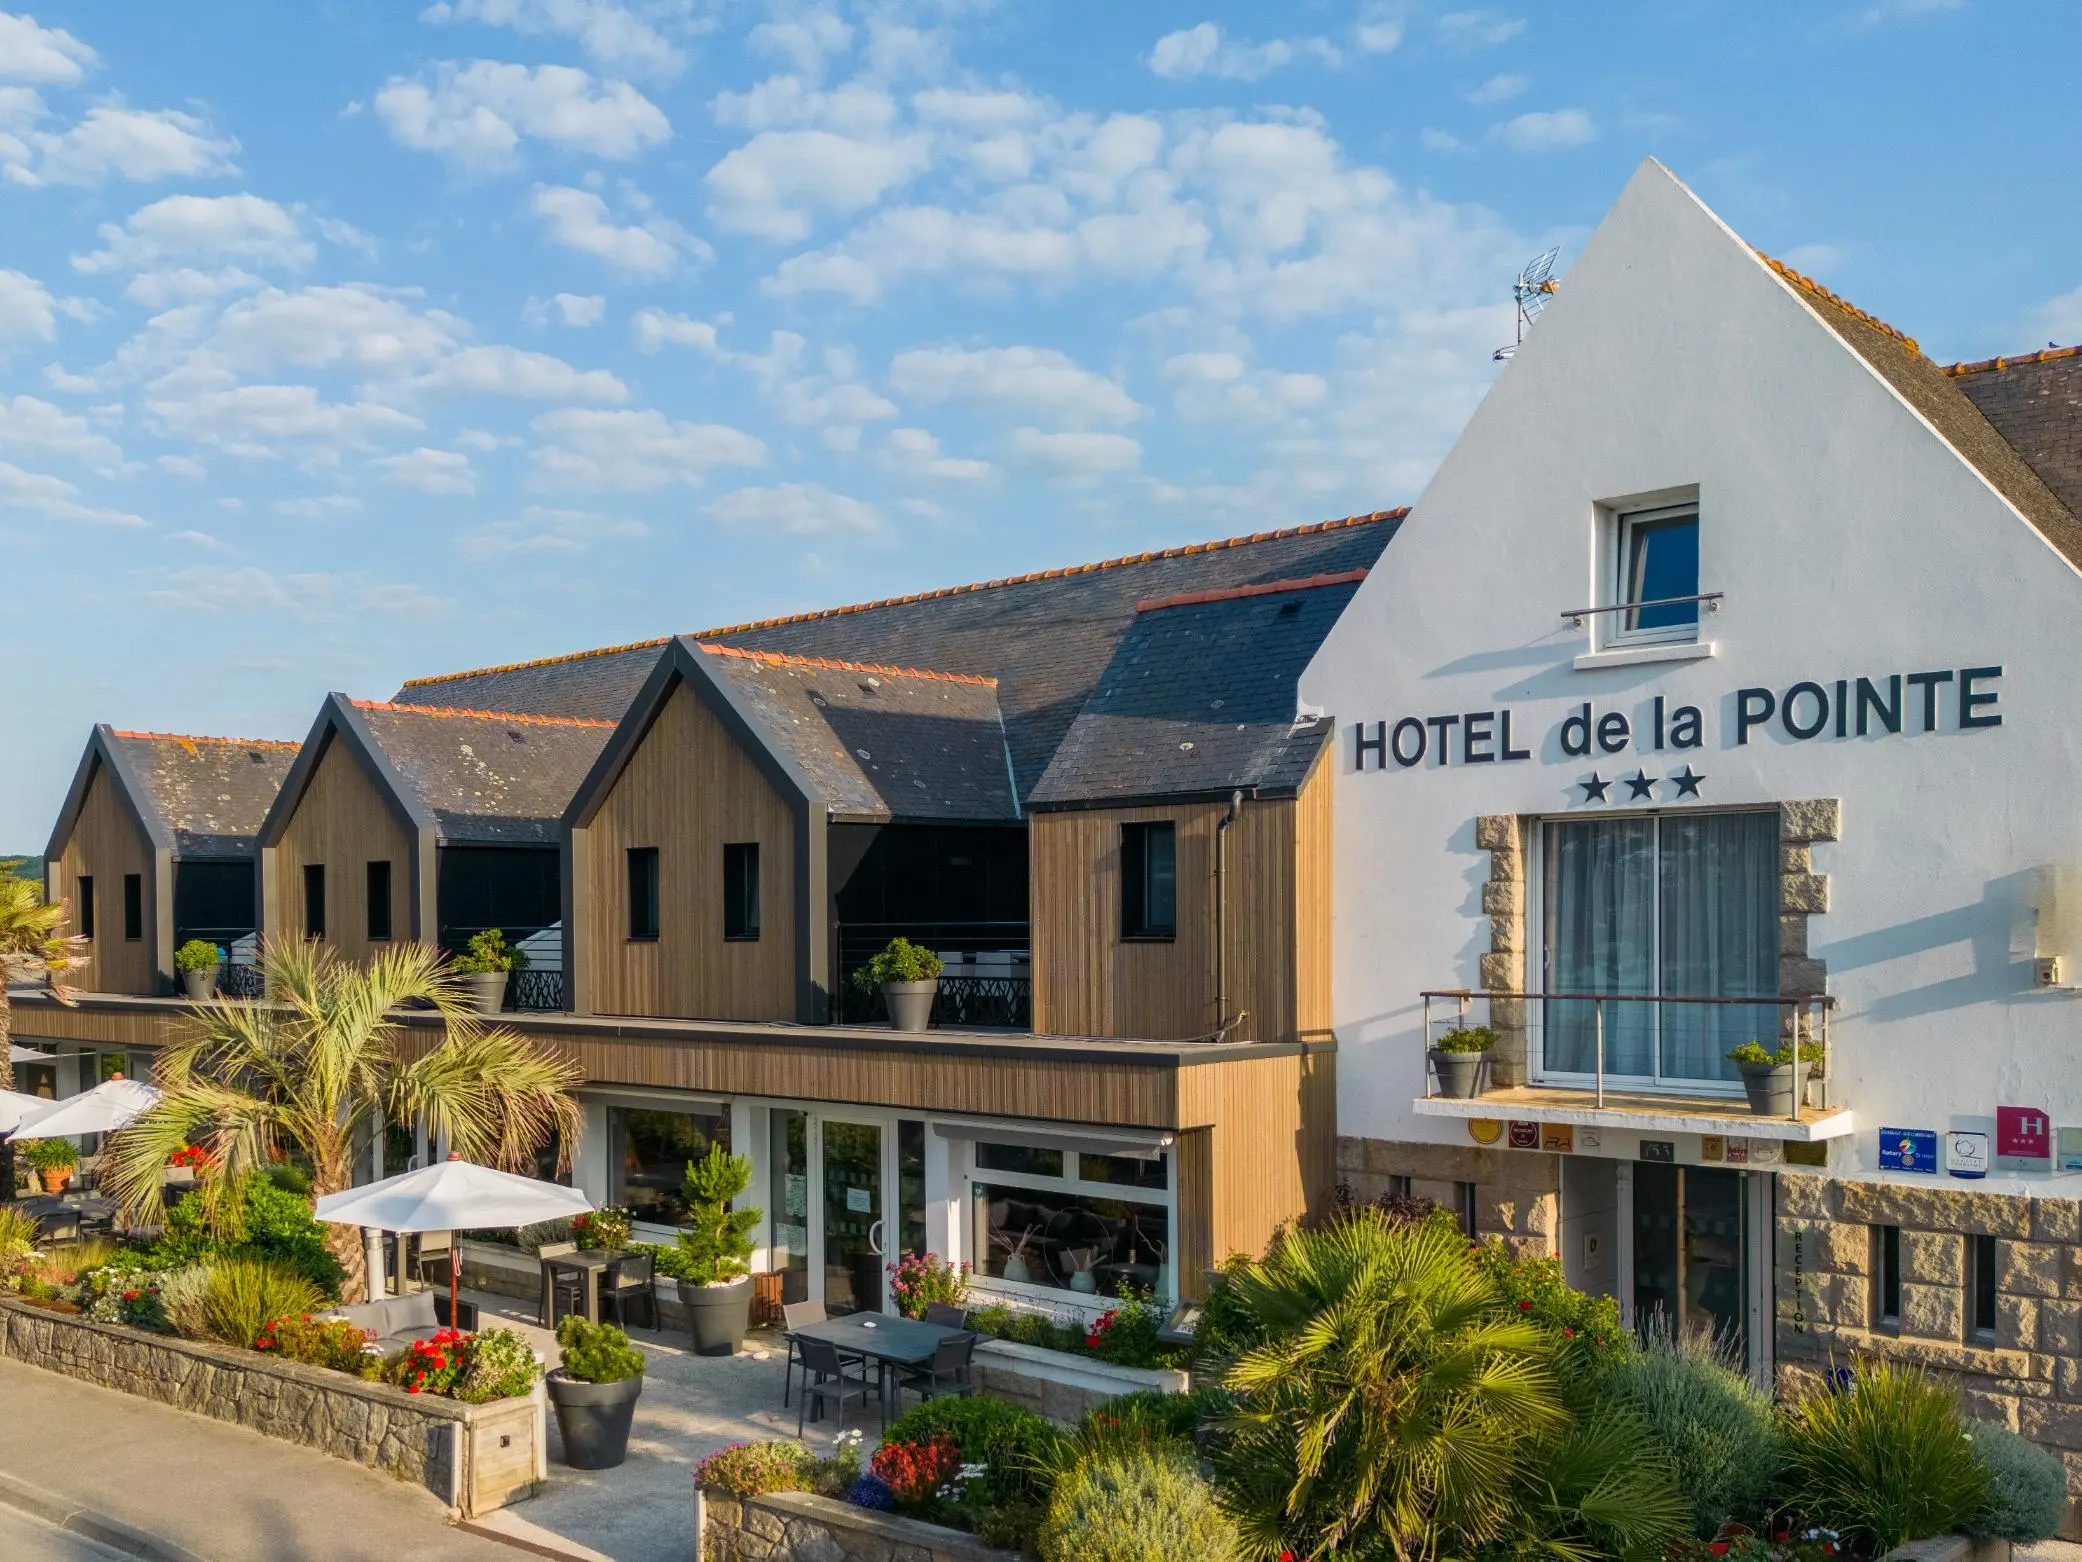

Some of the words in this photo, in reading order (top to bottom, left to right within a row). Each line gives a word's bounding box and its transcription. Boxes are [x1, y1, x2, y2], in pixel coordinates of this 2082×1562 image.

[1356, 709, 1531, 770] HOTEL
[1560, 702, 1630, 757] de
[1654, 695, 1704, 750] la
[1737, 665, 2003, 746] POINTE
[1881, 1149, 1902, 1159] Rotary
[2021, 1116, 2043, 1136] H
[1794, 1231, 1804, 1335] RECEPTION
